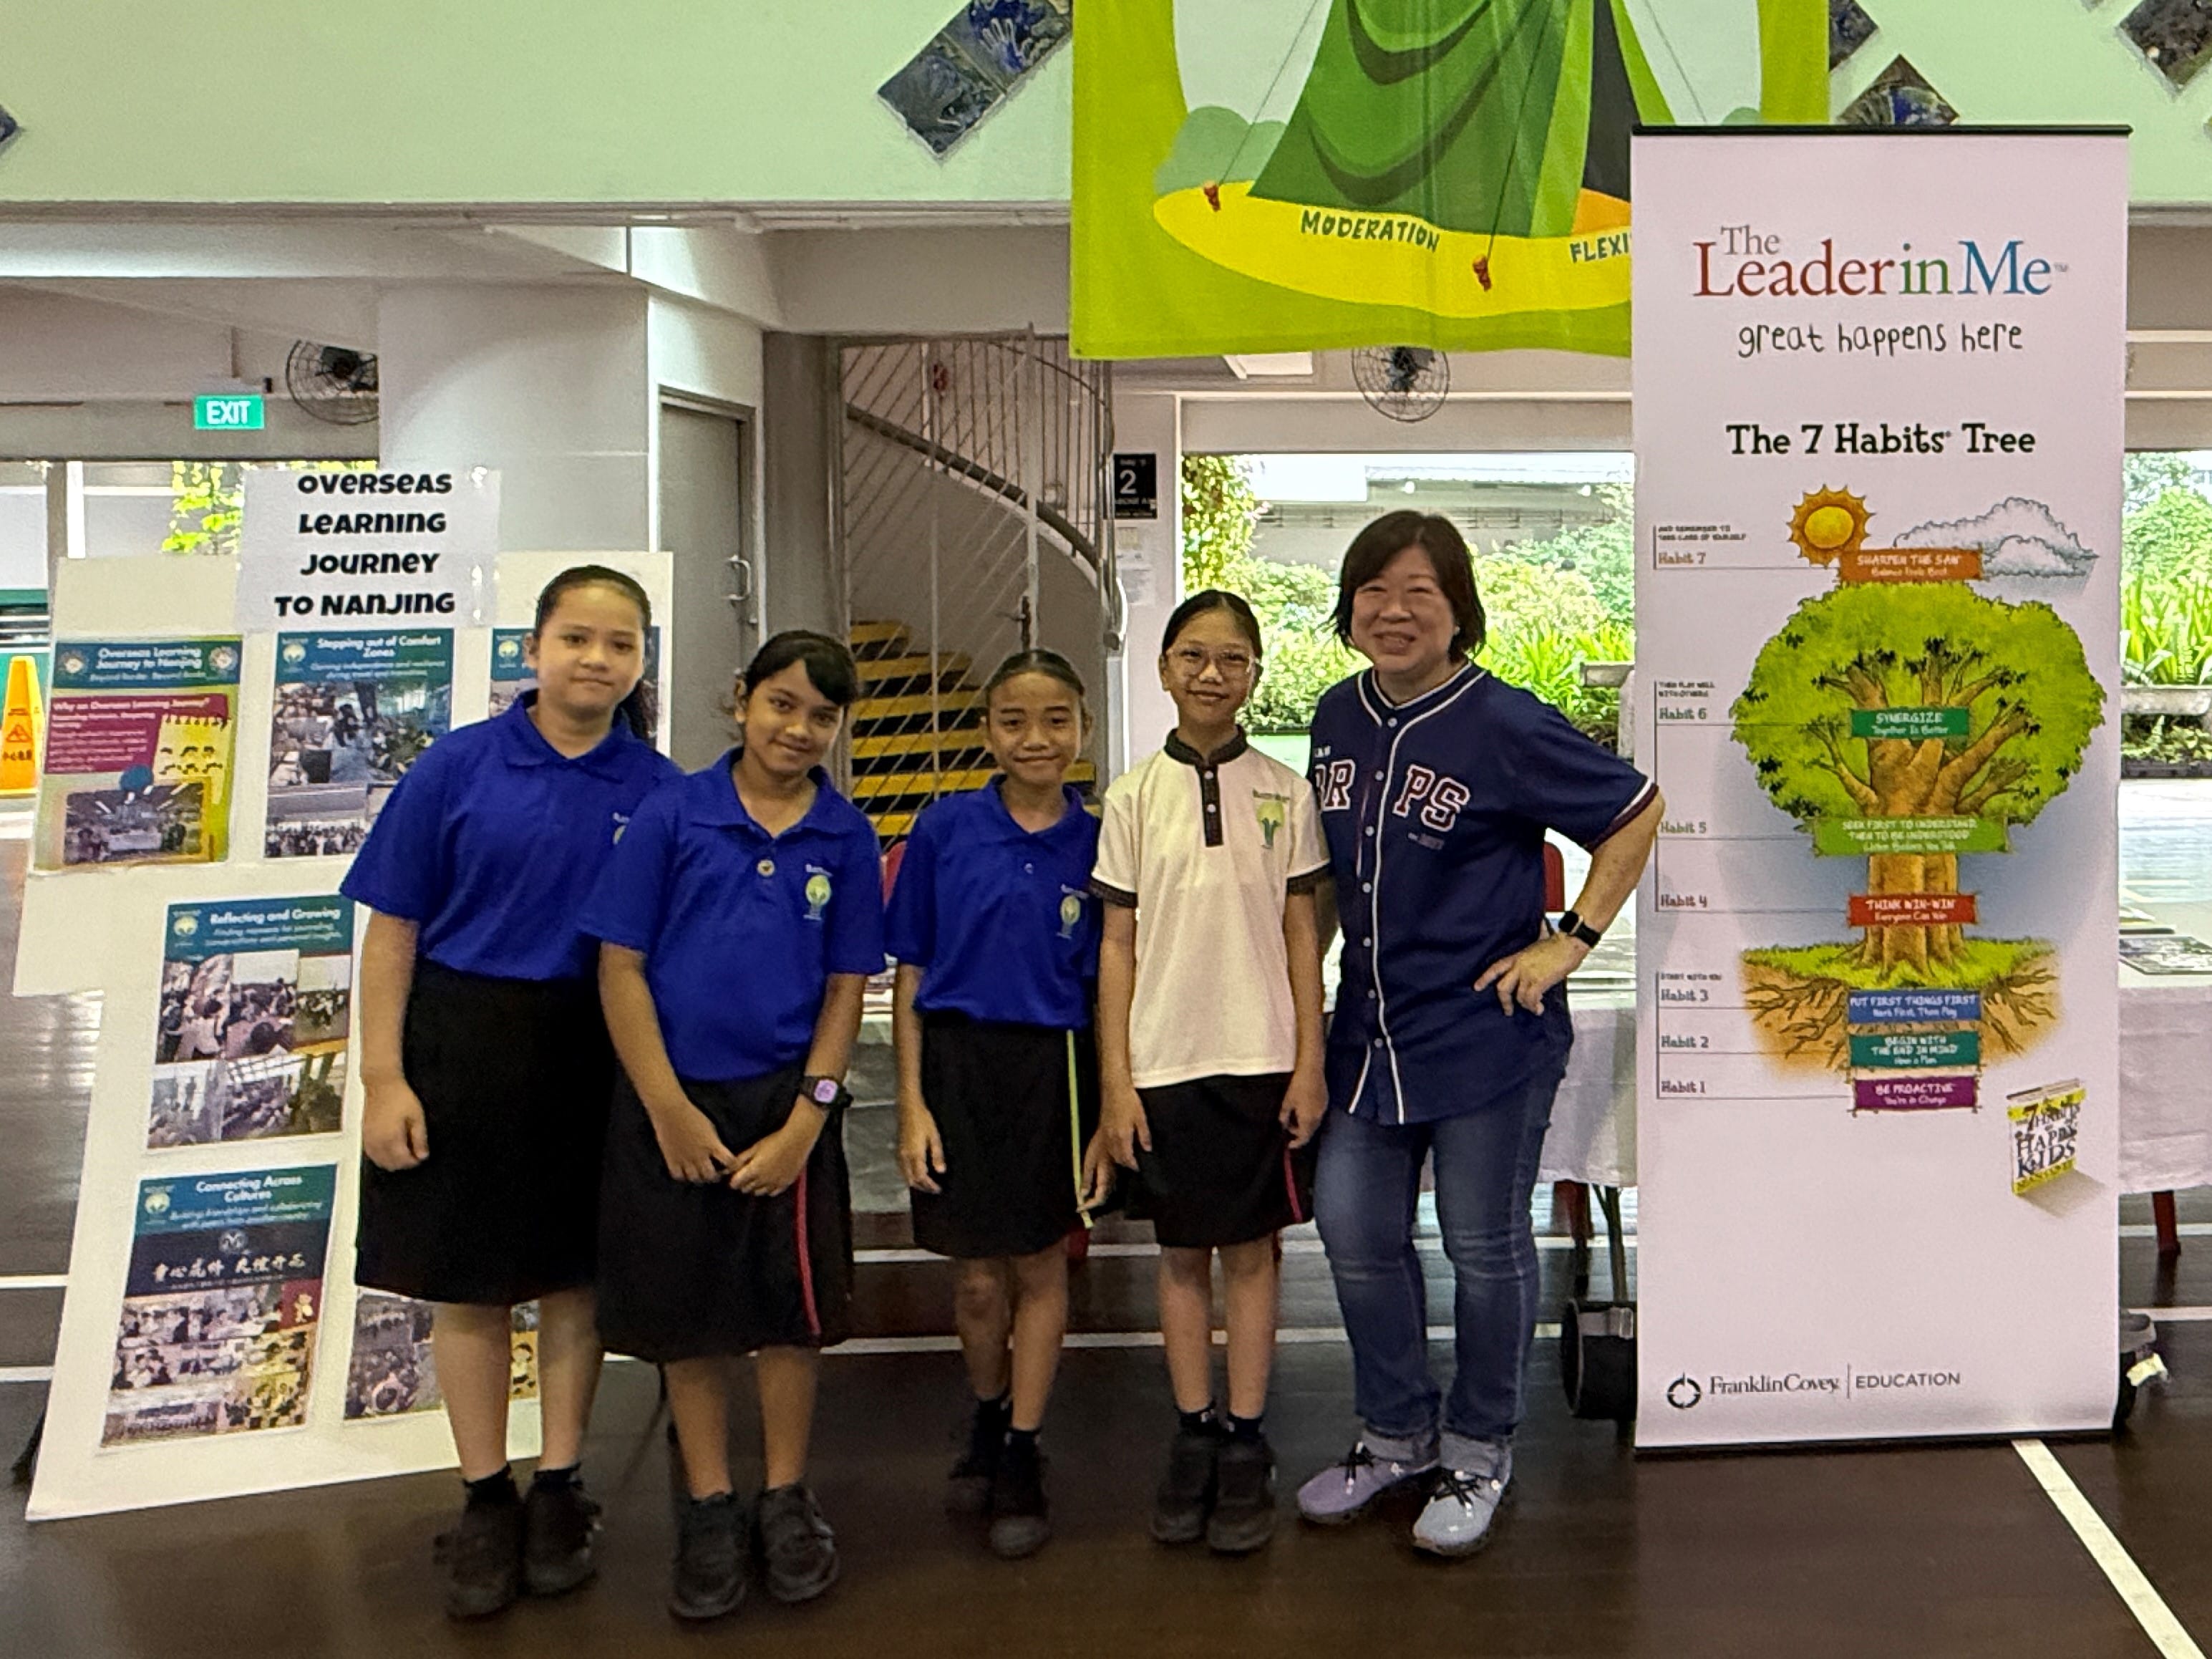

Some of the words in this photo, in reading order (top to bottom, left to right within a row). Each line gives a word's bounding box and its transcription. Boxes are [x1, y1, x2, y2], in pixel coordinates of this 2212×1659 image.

[1301, 210, 1440, 253] MODERATION
[1570, 233, 1631, 263] FLEXI
[1720, 225, 1781, 256] The
[1692, 238, 1896, 297] Leader
[1898, 243, 1953, 294] in
[1738, 324, 1825, 357] great
[1838, 322, 1947, 357] happens
[1961, 322, 2023, 352] here
[207, 400, 251, 425] EXIT
[1726, 424, 1791, 454] The
[1800, 424, 1824, 453] 7
[1961, 423, 2036, 453] Tree
[1120, 469, 1137, 494] 2
[1659, 551, 1694, 564] Habit
[1697, 552, 1706, 564] 7
[1910, 554, 1931, 566] THE
[274, 596, 314, 616] TO
[317, 637, 364, 650] Stepping
[385, 636, 397, 646] of
[1659, 707, 1694, 719] Habit
[1698, 707, 1707, 720] 6
[1392, 764, 1470, 832] PS
[1661, 821, 1695, 833] Habit
[1698, 821, 1707, 833] 5
[1661, 894, 1696, 907] Habit
[1699, 894, 1707, 907] 4
[1866, 899, 1902, 910] THINK
[210, 911, 265, 925] Reflecting
[266, 909, 289, 921] and
[292, 906, 341, 920] Growing
[1661, 988, 1697, 1001] Habit
[1699, 989, 1709, 1002] 3
[1870, 996, 1902, 1006] FIRST
[1661, 1035, 1697, 1048] Habit
[1699, 1035, 1709, 1048] 2
[1661, 1080, 1697, 1093] Habit
[1699, 1080, 1705, 1093] 1
[1876, 1084, 1890, 1095] BE
[2018, 1142, 2076, 1178] KIDS
[195, 1177, 262, 1193] Connecting
[263, 1176, 302, 1188] Across
[224, 1190, 272, 1203] Cultures
[1856, 1372, 1961, 1389] EDUCATION
